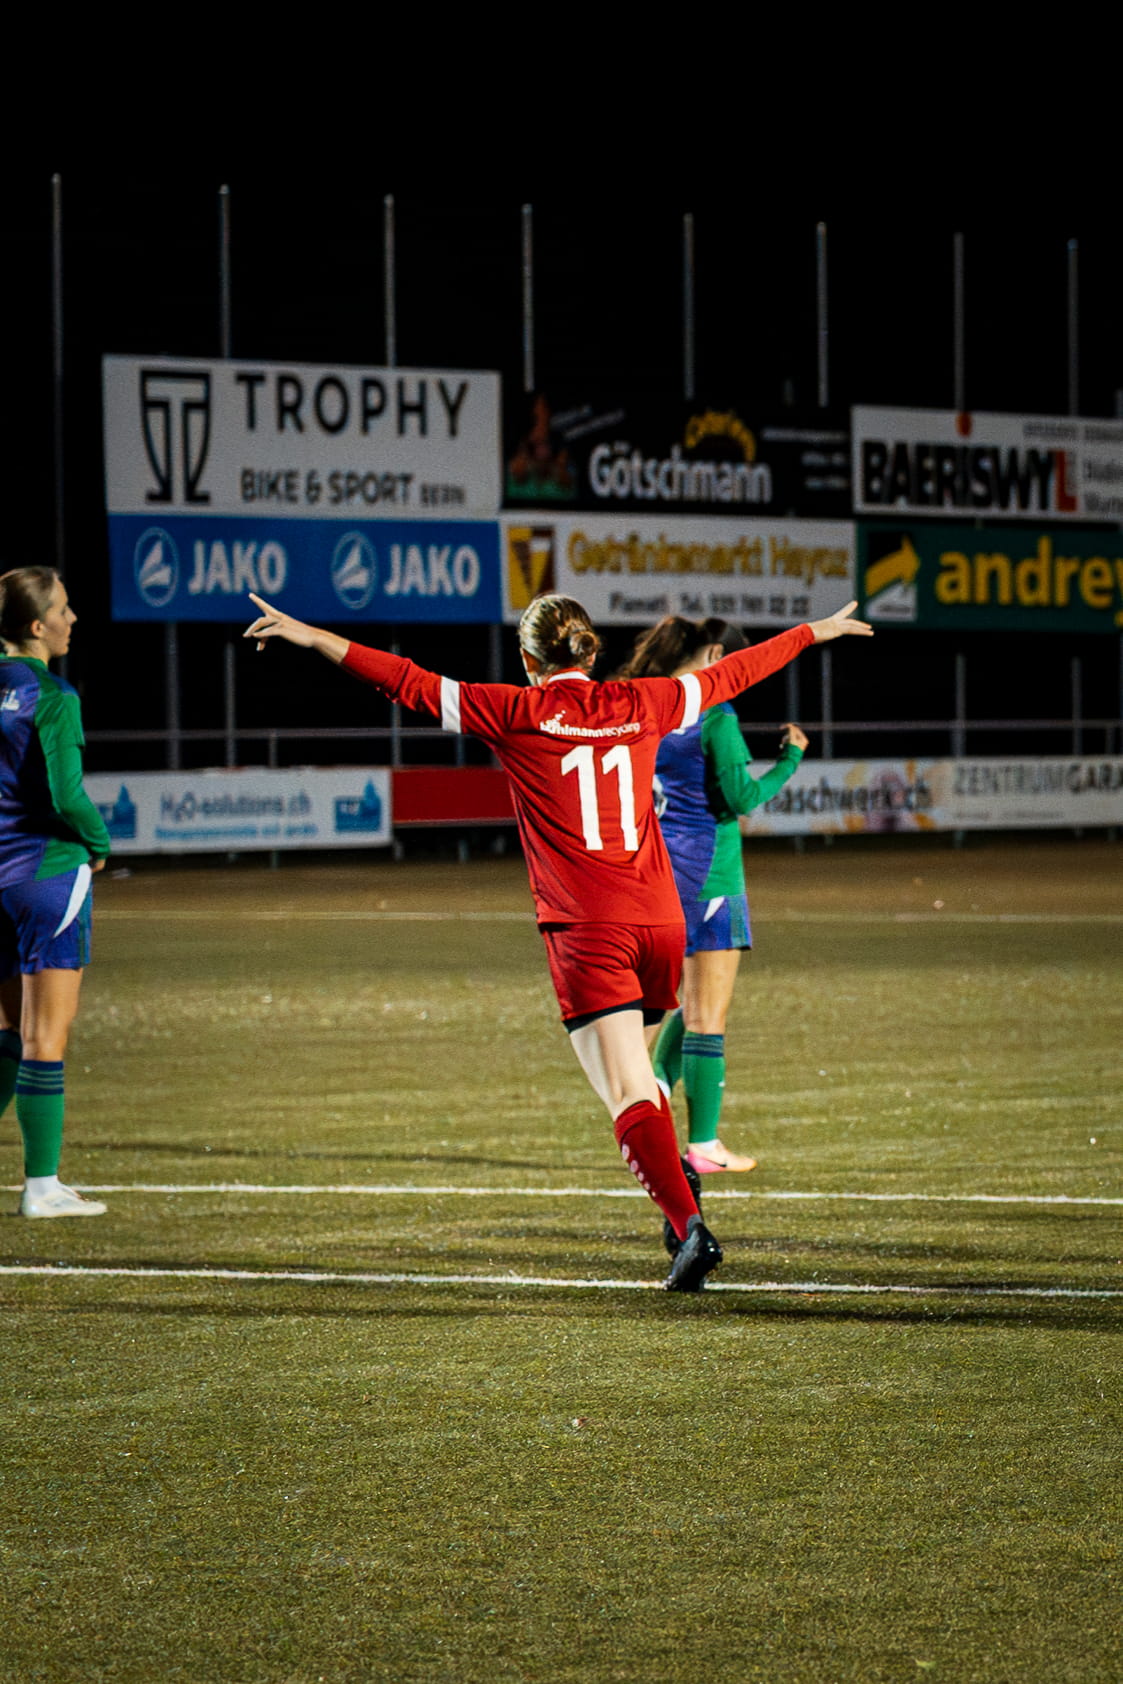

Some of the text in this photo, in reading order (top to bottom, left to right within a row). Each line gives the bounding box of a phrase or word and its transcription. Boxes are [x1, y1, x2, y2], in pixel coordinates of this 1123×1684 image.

[235, 372, 468, 438] TROPHY
[241, 468, 299, 502] BIKE
[305, 469, 322, 504] &
[328, 470, 414, 505] SPORT
[589, 440, 772, 503] Götschmann
[862, 438, 1078, 513] BAERISWYL
[188, 539, 287, 596] JAKO
[385, 543, 482, 598] JAKO
[935, 535, 1123, 628] andre
[561, 744, 640, 852] 11
